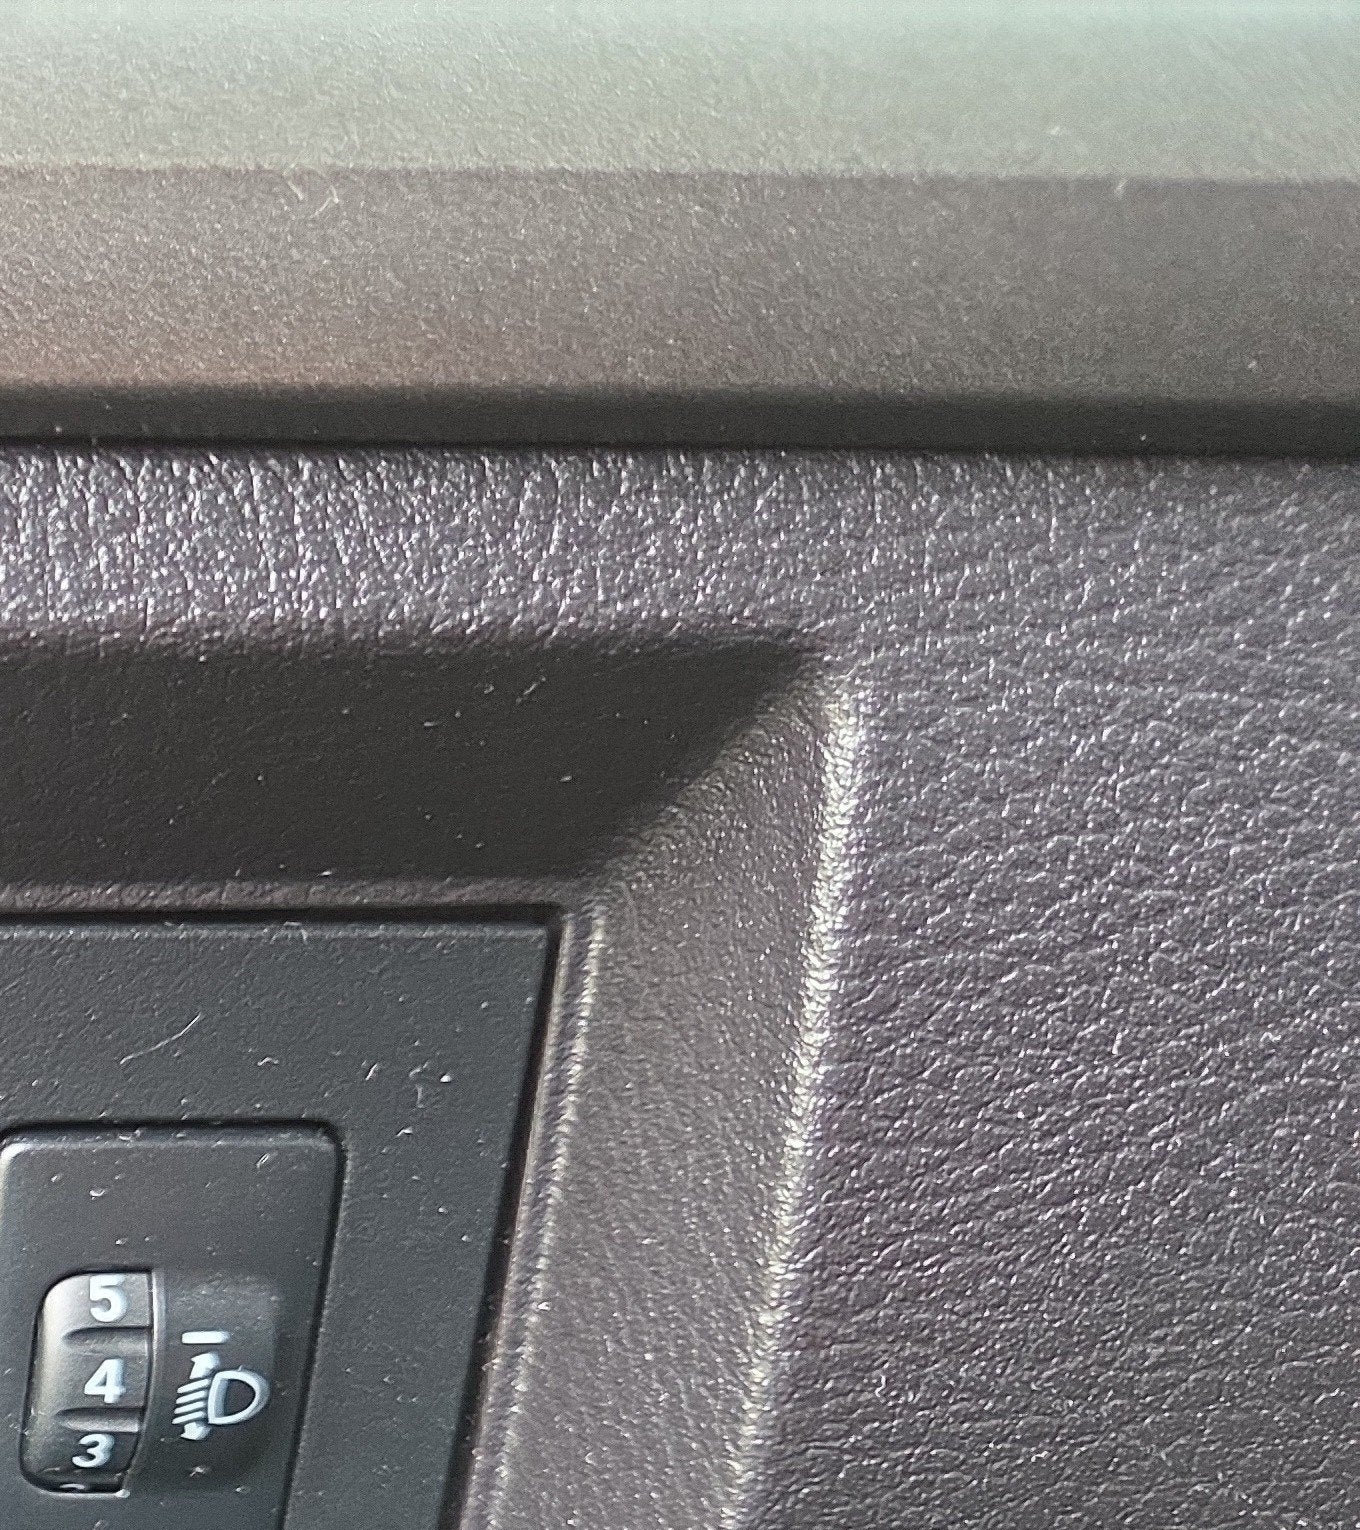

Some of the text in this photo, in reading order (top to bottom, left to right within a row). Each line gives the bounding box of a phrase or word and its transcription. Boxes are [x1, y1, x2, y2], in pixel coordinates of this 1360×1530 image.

[88, 1275, 129, 1323] 5
[83, 1358, 126, 1404] 4
[71, 1433, 113, 1469] 3
